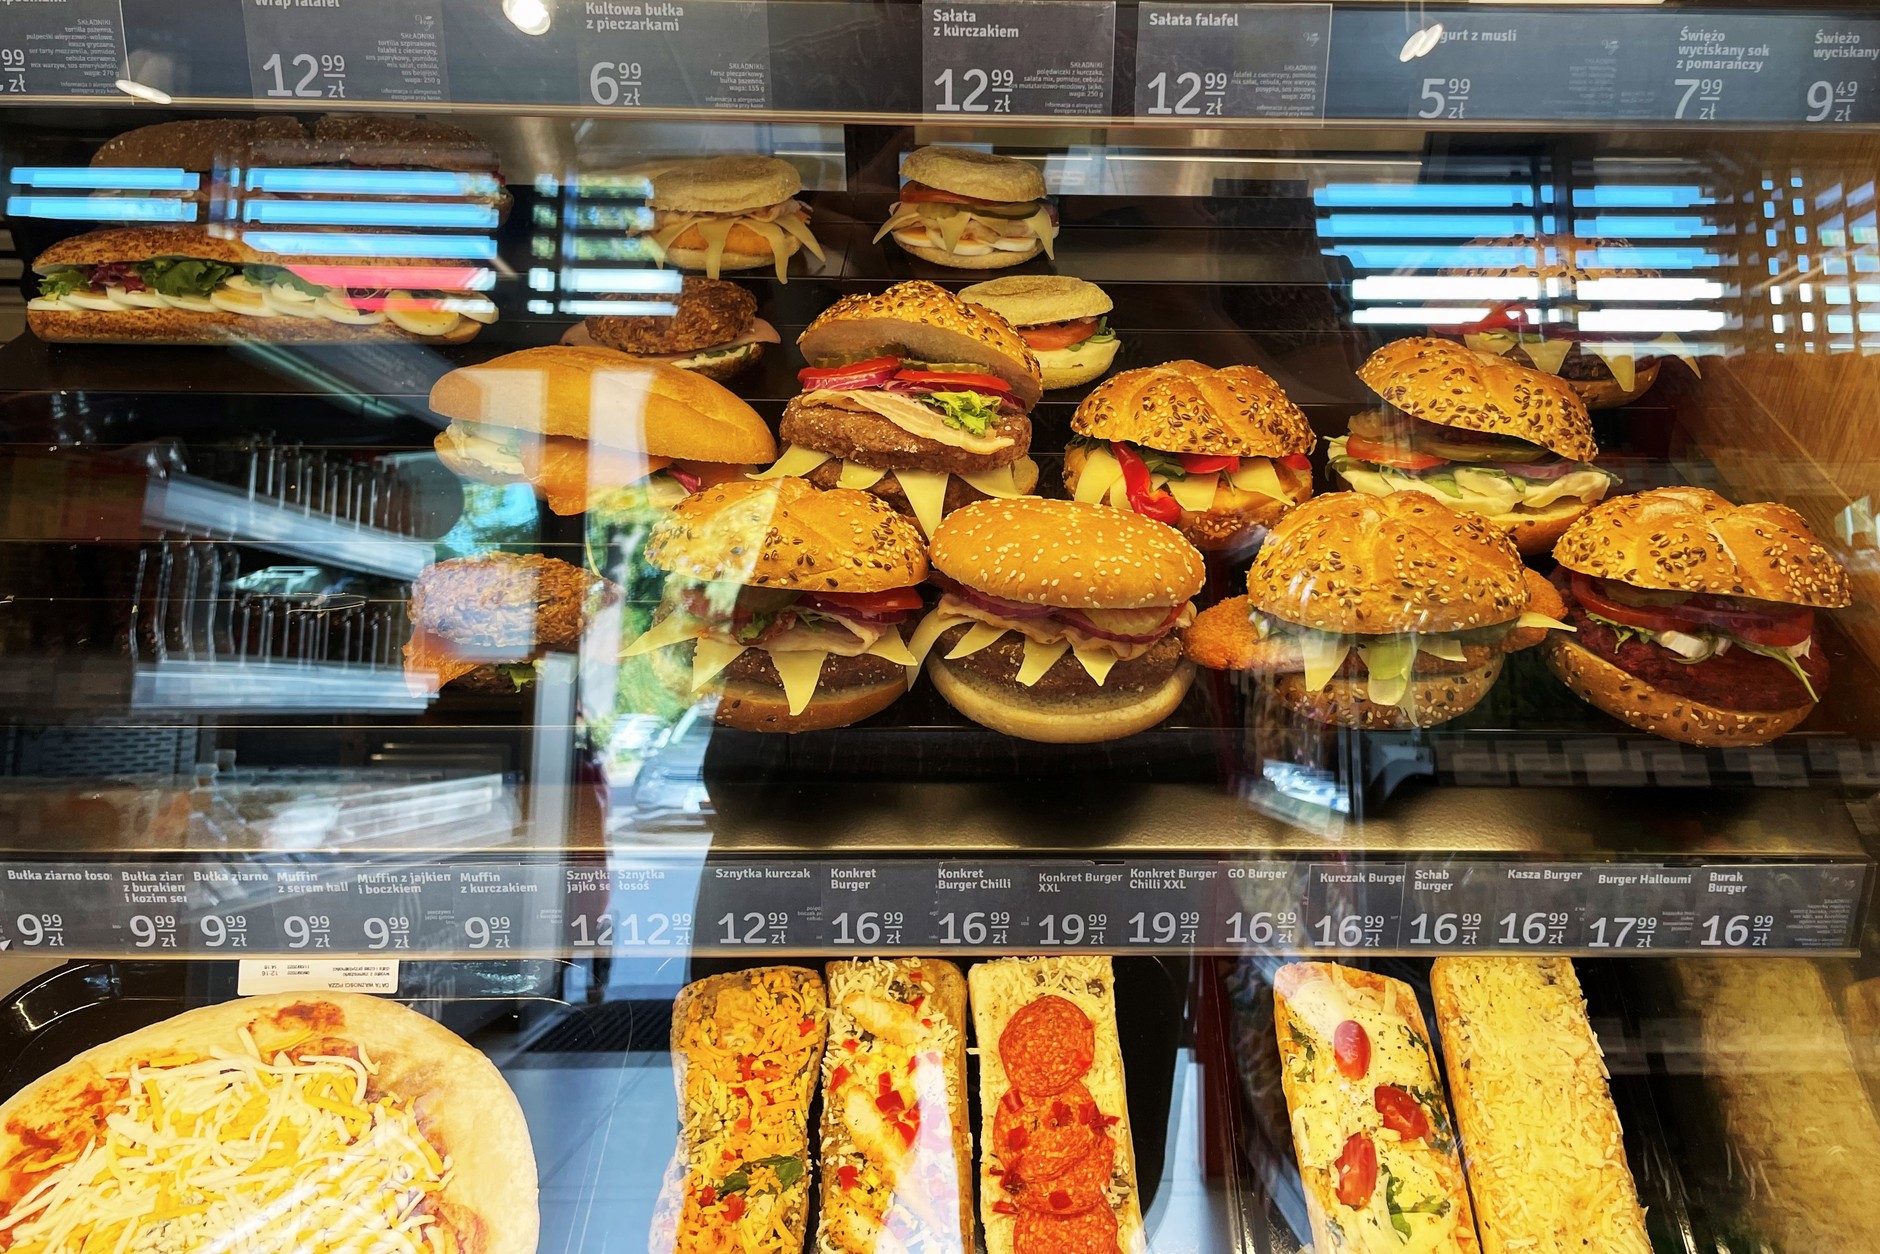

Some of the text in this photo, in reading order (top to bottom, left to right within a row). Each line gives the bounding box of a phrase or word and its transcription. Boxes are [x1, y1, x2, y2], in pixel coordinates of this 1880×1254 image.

[586, 2, 684, 17] Kultowa bułka
[933, 9, 976, 22] Sałata
[586, 17, 680, 32] z pieczarkami
[1149, 12, 1239, 27] Sałata falafel
[933, 24, 1019, 38] z kurczakiem
[1440, 29, 1517, 44] gurt z musli
[1814, 28, 1861, 44] Świeżo
[1678, 41, 1770, 58] wyciskany sok
[1813, 45, 1880, 60] wyciskany
[1, 49, 27, 93] 99 zł
[1676, 57, 1764, 73] z pomarańczy
[262, 54, 346, 98] 12 99 zł
[590, 61, 642, 106] 6 99 zł
[1701, 79, 1723, 95] 99
[934, 68, 1014, 113] 12 99 zł
[1147, 72, 1227, 115] 12 99 zł
[1418, 78, 1471, 119] 5 99 zł
[1674, 78, 1700, 119] 7
[1806, 80, 1858, 122] 9 49 zł
[1699, 103, 1716, 120] zł
[7, 870, 43, 881] Bułka
[45, 871, 82, 881] ziarno
[121, 871, 185, 882] Bułka ziar
[193, 872, 269, 882] Bułka ziarno
[277, 872, 318, 883] Muffin
[357, 873, 398, 884] Muffin
[401, 874, 408, 883] z
[460, 872, 500, 883] Muffin
[618, 869, 665, 881] Sznytka
[715, 868, 811, 881] Sznytka kurczak
[831, 868, 876, 878] Konkret
[938, 868, 984, 878] Konkret
[1038, 872, 1123, 884] Konkret Burger
[1130, 868, 1217, 880] Konkret Burger
[1227, 868, 1287, 881] GO Burger
[1320, 872, 1366, 883] Kurczak
[1414, 869, 1449, 880] Schab
[1507, 869, 1583, 881] Kasza Burger
[1709, 872, 1743, 882] Burak
[618, 880, 650, 891] łosoś
[831, 879, 870, 891] Burger
[938, 878, 1011, 891] Burger Chilli
[1129, 879, 1186, 889] Chilli XXL
[1598, 874, 1692, 886] Burger Halloumi
[287, 885, 323, 894] serem
[358, 884, 421, 895] i boczkiem
[470, 883, 538, 893] kurczakiem
[567, 881, 597, 894] jajko
[1038, 883, 1061, 893] XXL
[1414, 881, 1453, 893] Burger
[1708, 883, 1747, 895] Burger
[125, 894, 130, 903] i
[132, 893, 167, 903] kozim
[41, 914, 63, 927] 99
[154, 915, 176, 928] 99
[388, 916, 410, 929] 99
[489, 916, 511, 929] 99
[768, 912, 788, 925] 99
[883, 912, 904, 925] 99
[990, 912, 1010, 925] 99
[1088, 914, 1107, 926] 99
[1548, 912, 1569, 925] 99
[1637, 917, 1657, 929] 99
[1753, 915, 1773, 927] 99
[17, 914, 44, 946] 9
[130, 915, 156, 947] 9
[200, 915, 247, 947] 9 99 zł
[284, 915, 330, 948] 9 99 zł
[363, 917, 389, 949] 9
[464, 917, 490, 949] 9
[621, 913, 692, 945] 12 99 zł
[718, 912, 767, 944] 12
[831, 912, 881, 944] 16
[938, 912, 987, 944] 16
[1038, 914, 1085, 945] 19
[1128, 912, 1200, 943] 19 99 zł
[1225, 912, 1297, 943] 16 99 zł
[1314, 915, 1385, 946] 16 99 zł
[1409, 913, 1482, 945] 16 99 zł
[1498, 912, 1547, 944] 16
[1588, 917, 1637, 947] 17
[1700, 915, 1750, 946] 16
[48, 933, 64, 946] zł
[161, 934, 177, 947] zł
[394, 935, 410, 948] zł
[495, 935, 510, 948] zł
[771, 930, 786, 944] zł
[886, 930, 901, 944] zł
[992, 930, 1007, 944] zł
[1090, 931, 1104, 945] zł
[1548, 931, 1563, 944] zł
[1636, 935, 1652, 948] zł
[1752, 933, 1768, 946] zł
